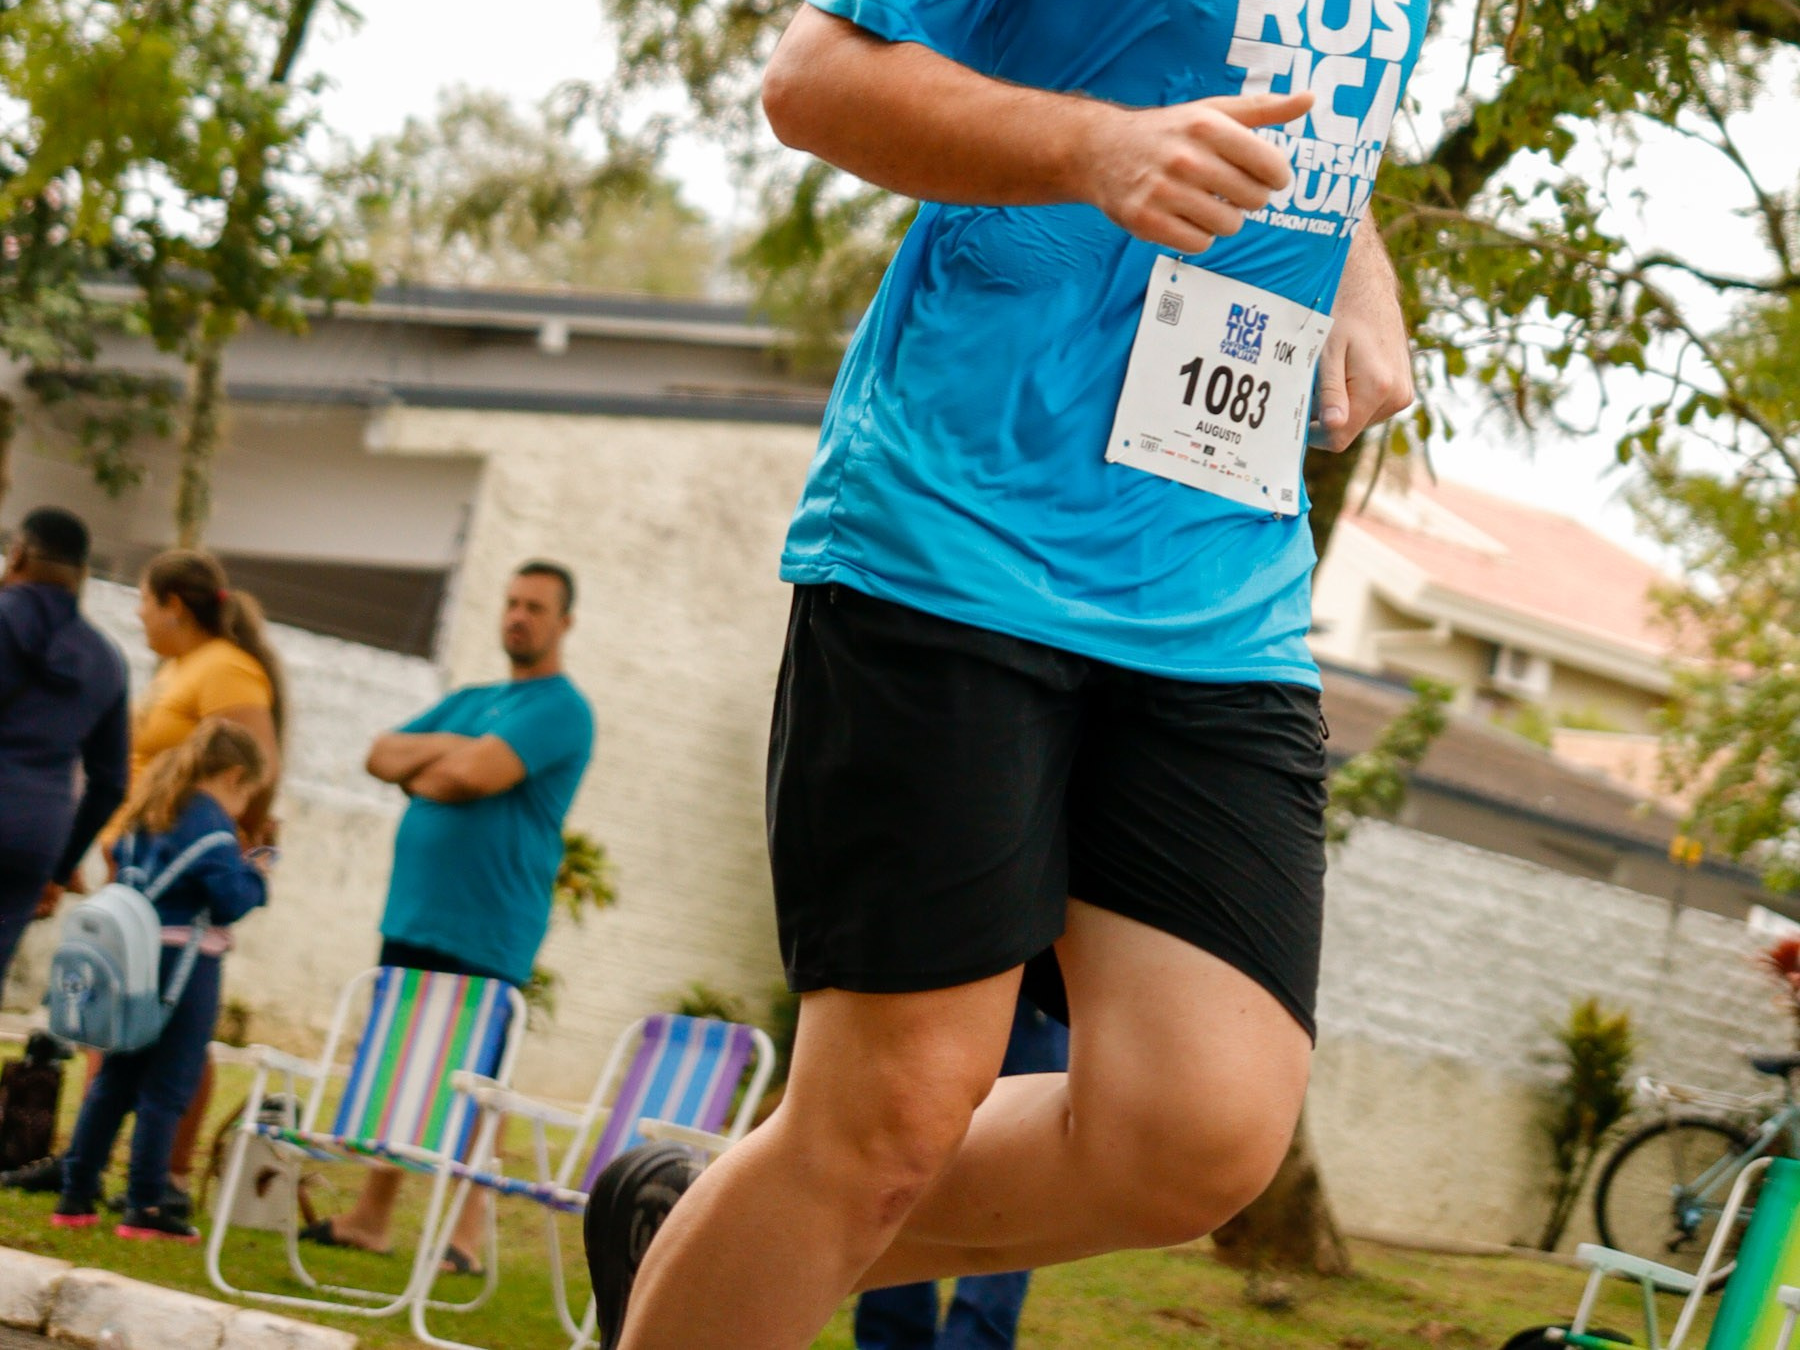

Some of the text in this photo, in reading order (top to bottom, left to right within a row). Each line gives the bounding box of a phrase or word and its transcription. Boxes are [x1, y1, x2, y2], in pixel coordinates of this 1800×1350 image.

[1269, 212, 1308, 232] 10KM
[1307, 218, 1337, 236] KIDS
[1227, 302, 1270, 332] RÚS
[1226, 321, 1263, 348] TICA
[1273, 339, 1297, 365] 10K
[1178, 356, 1271, 429] 1083
[1196, 420, 1242, 445] AUGUSTO
